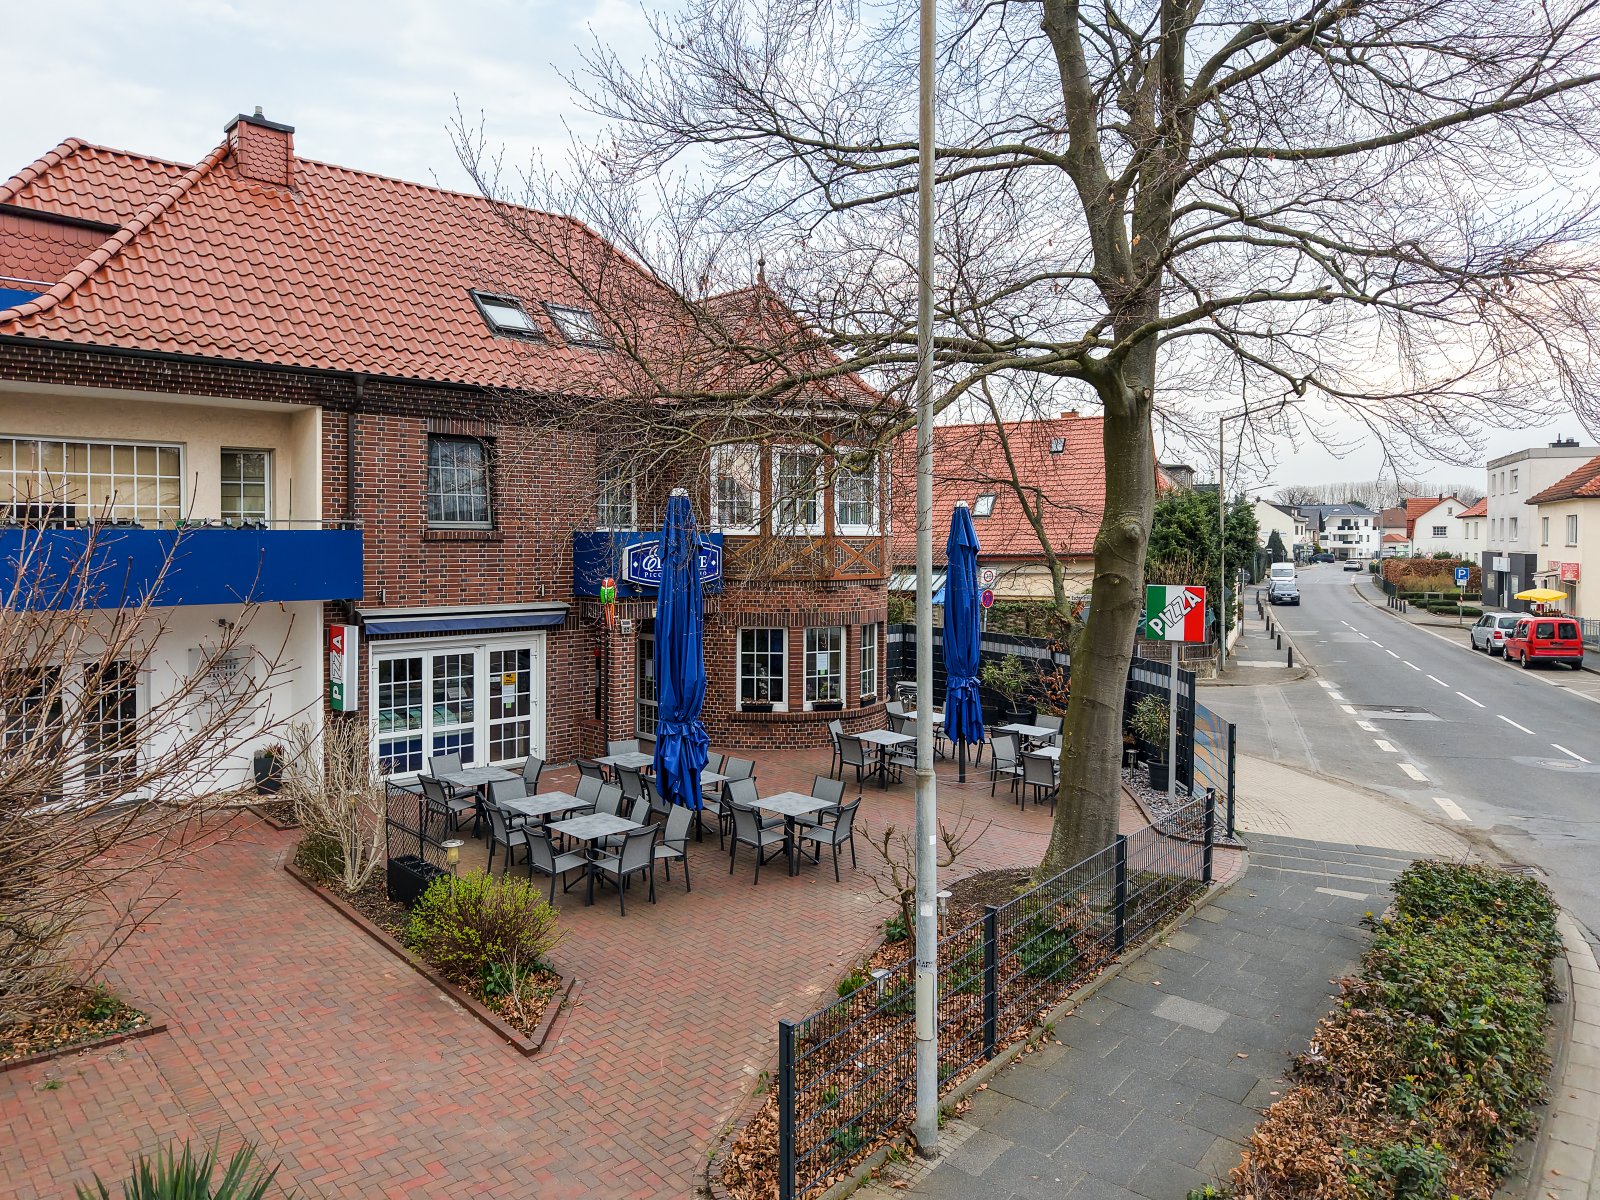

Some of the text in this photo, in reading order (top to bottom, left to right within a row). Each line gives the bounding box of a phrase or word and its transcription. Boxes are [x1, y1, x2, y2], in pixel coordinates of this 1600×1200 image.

[1458, 569, 1466, 579] P
[1148, 590, 1202, 636] PIZZA
[332, 635, 342, 700] PIZZA
